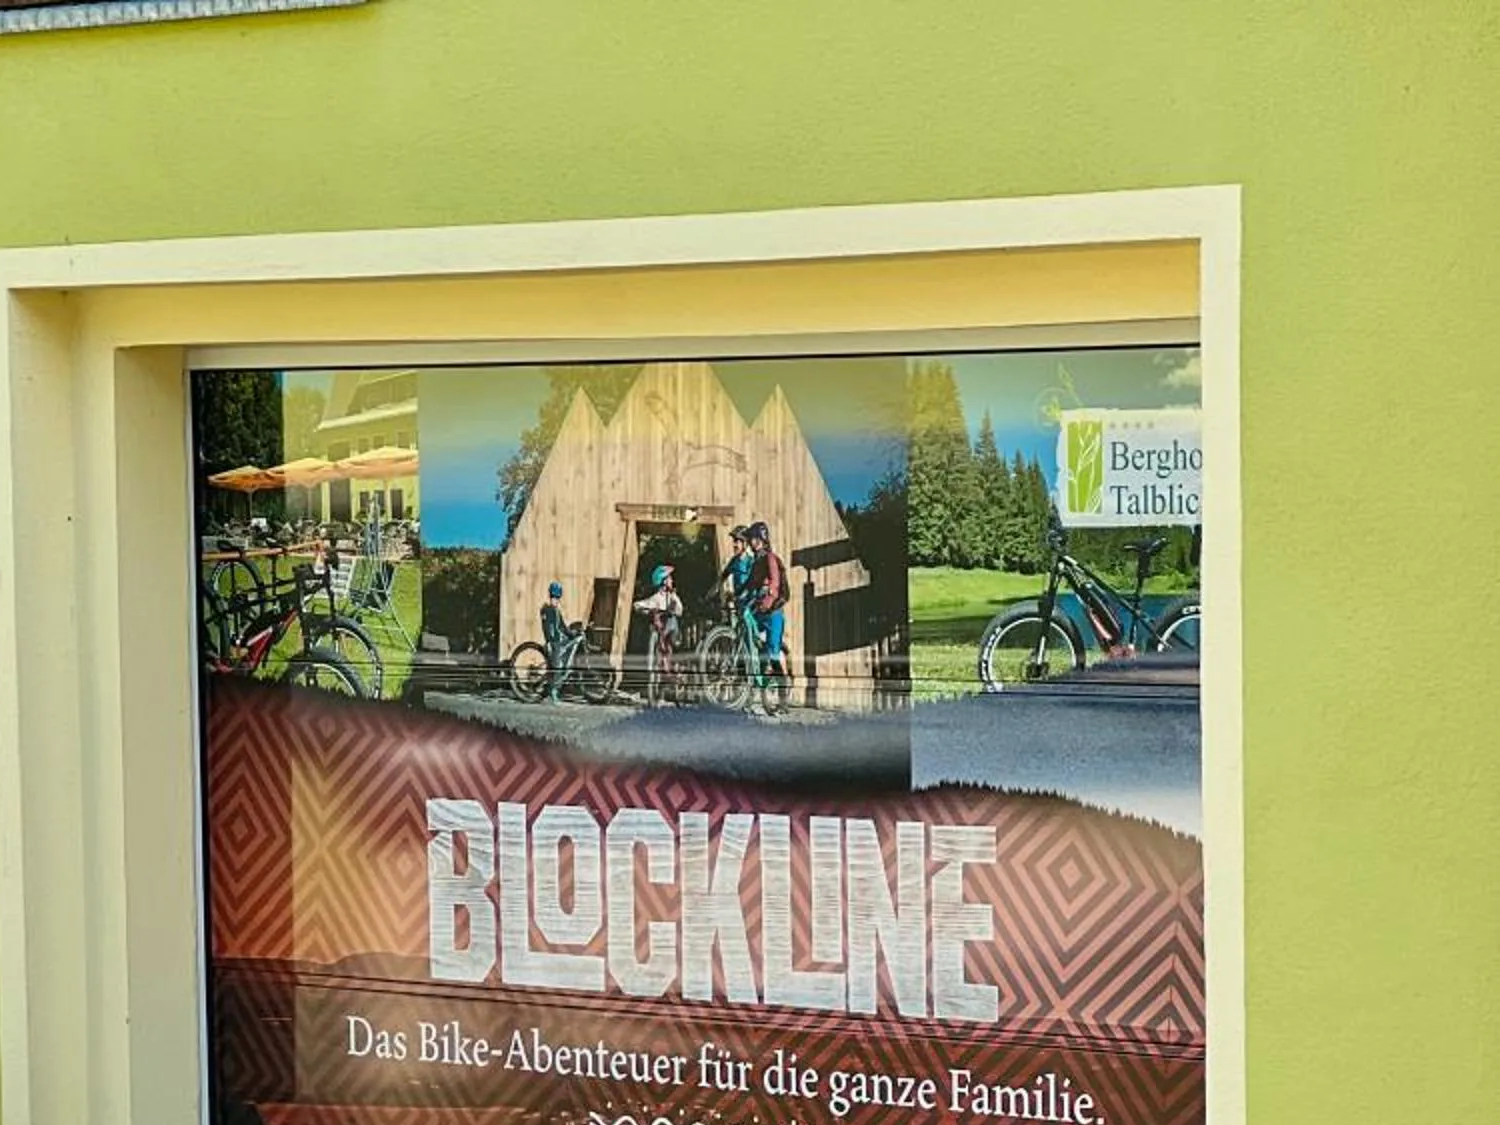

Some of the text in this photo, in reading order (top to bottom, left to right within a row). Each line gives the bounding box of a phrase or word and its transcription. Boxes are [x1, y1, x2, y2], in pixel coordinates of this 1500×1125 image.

[1111, 438, 1203, 479] Bergho
[1109, 483, 1200, 516] Talblic
[426, 797, 999, 1022] BLOCKLINE
[346, 1016, 1105, 1125] Das Bike-Abenteuer für die ganze Familie.
